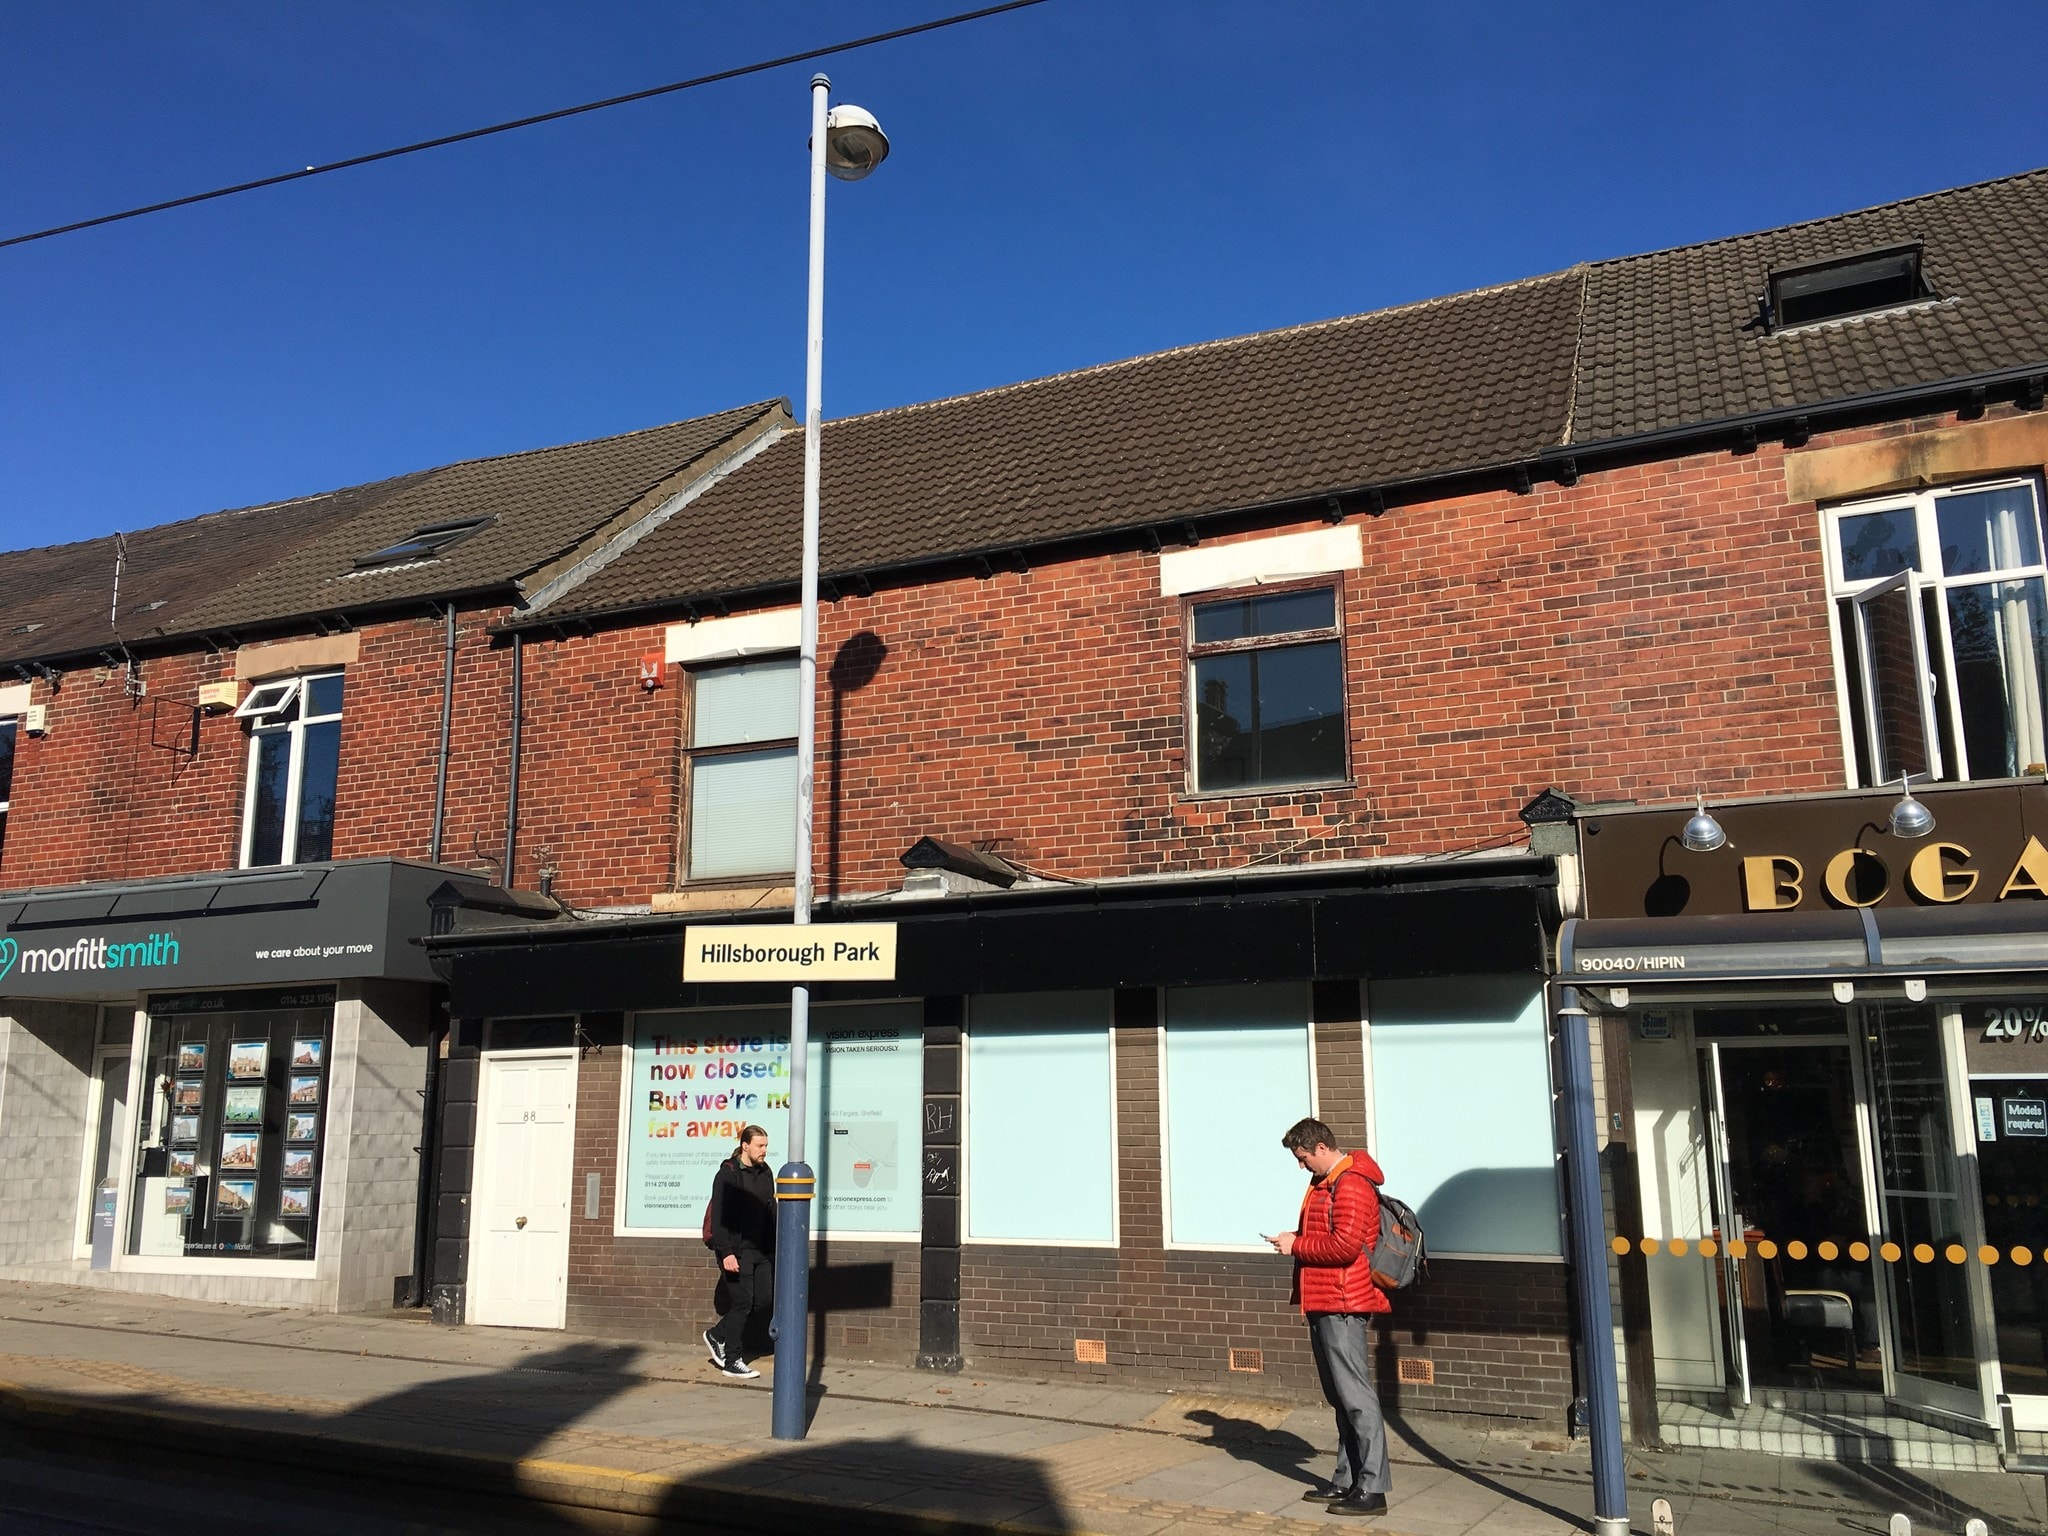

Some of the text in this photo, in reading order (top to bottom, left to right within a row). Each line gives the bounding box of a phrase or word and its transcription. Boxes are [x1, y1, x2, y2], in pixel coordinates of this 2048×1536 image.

[20, 932, 179, 974] morfittsmith
[255, 944, 373, 959] we care about your move
[701, 942, 880, 966] Hillsborough Park
[1581, 956, 1686, 971] 90040/HIPIN
[826, 1028, 899, 1040] vision express
[651, 1031, 789, 1056] This store is
[650, 1056, 790, 1081] now closed.
[648, 1088, 790, 1112] But we're no
[524, 1110, 536, 1122] 88
[2008, 1104, 2042, 1116] Models
[648, 1117, 680, 1138] far
[2008, 1118, 2044, 1131] required
